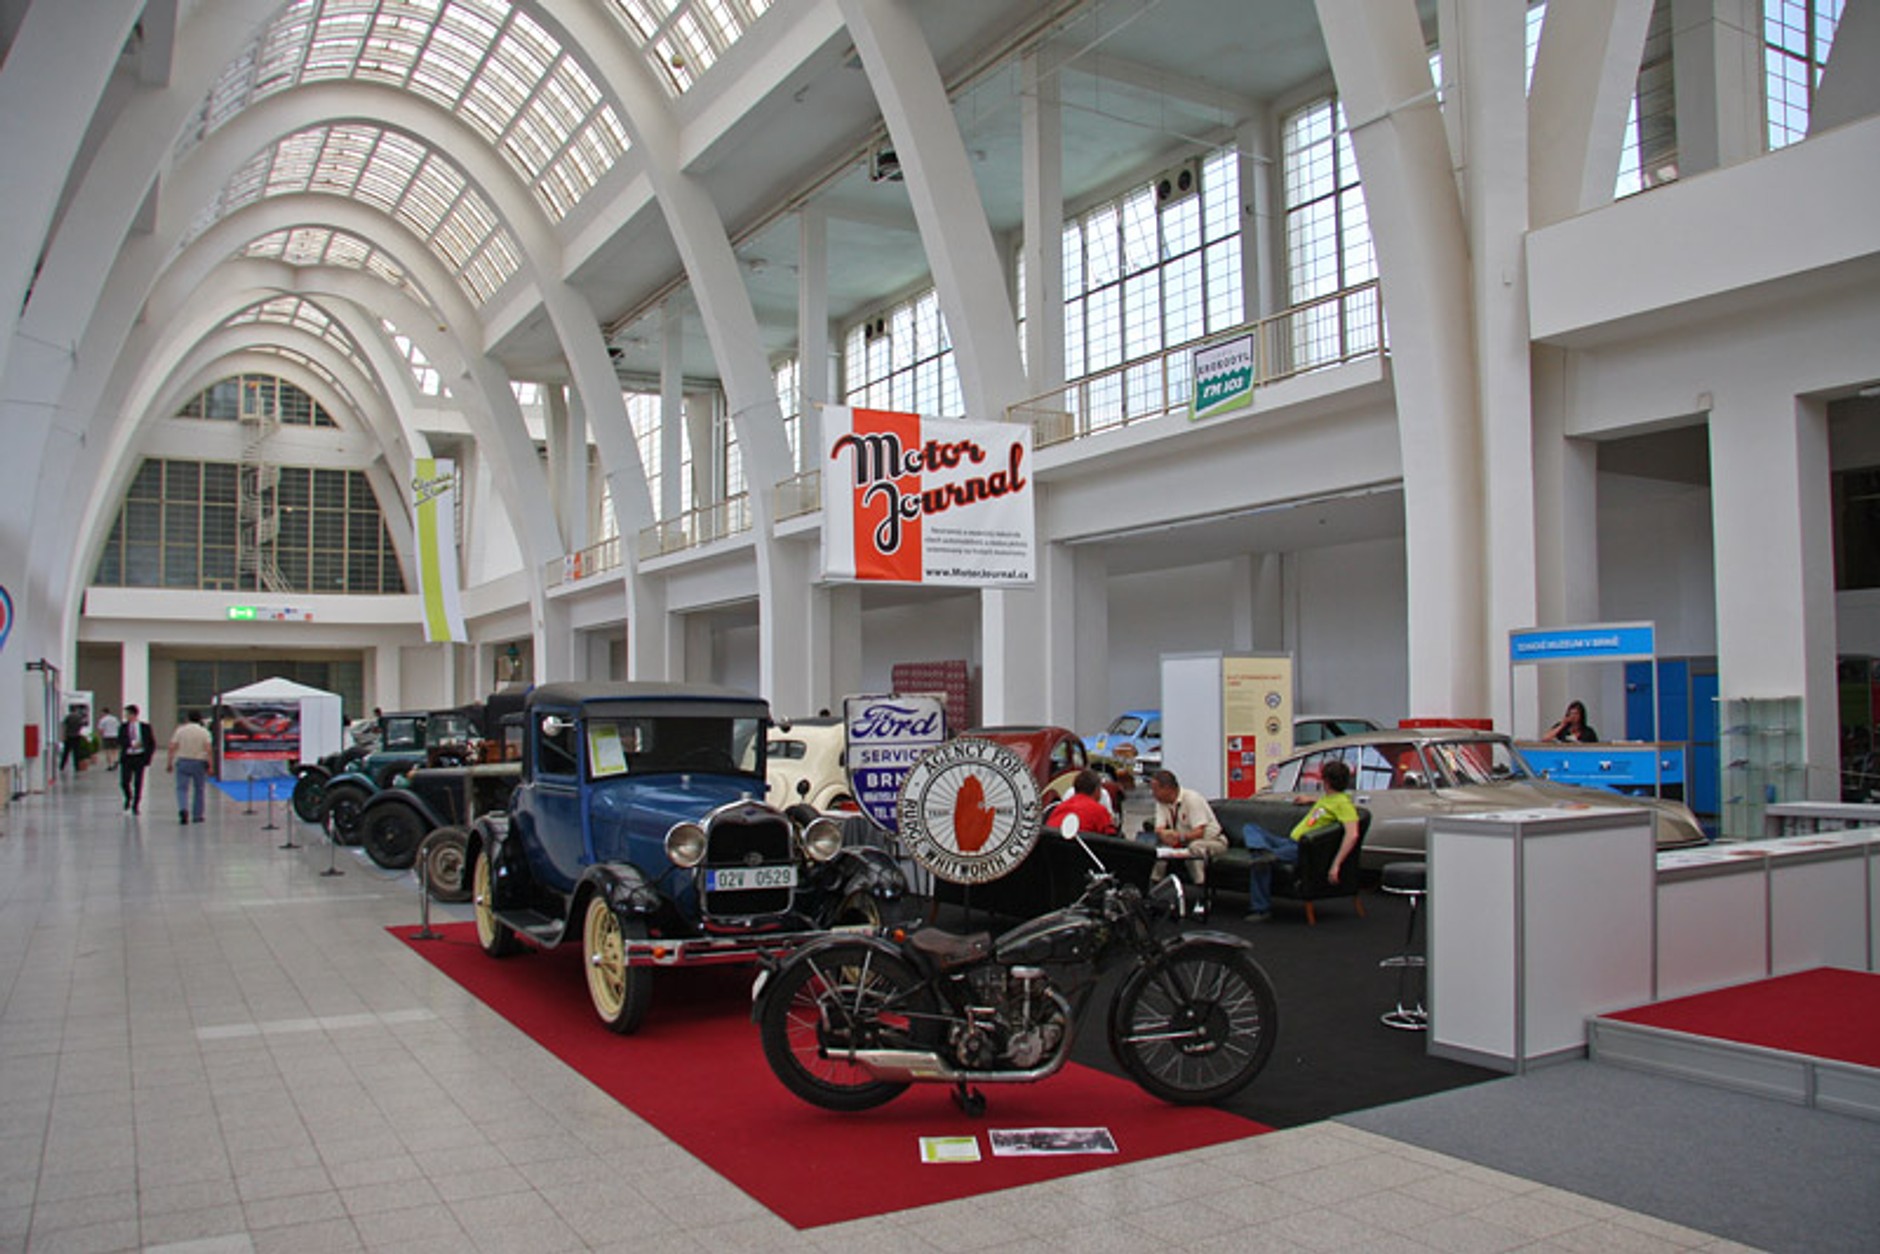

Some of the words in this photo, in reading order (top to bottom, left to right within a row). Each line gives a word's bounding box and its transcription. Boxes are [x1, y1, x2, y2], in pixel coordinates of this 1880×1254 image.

[831, 432, 986, 486] Motor
[864, 441, 1027, 553] Journal
[851, 704, 939, 739] Ford
[924, 744, 986, 775] AGENCY
[992, 749, 1021, 776] FOR
[867, 773, 906, 788] BRN
[925, 850, 1008, 877] WHITWORTH
[1008, 801, 1035, 857] CYCLES
[755, 869, 791, 886] 0529
